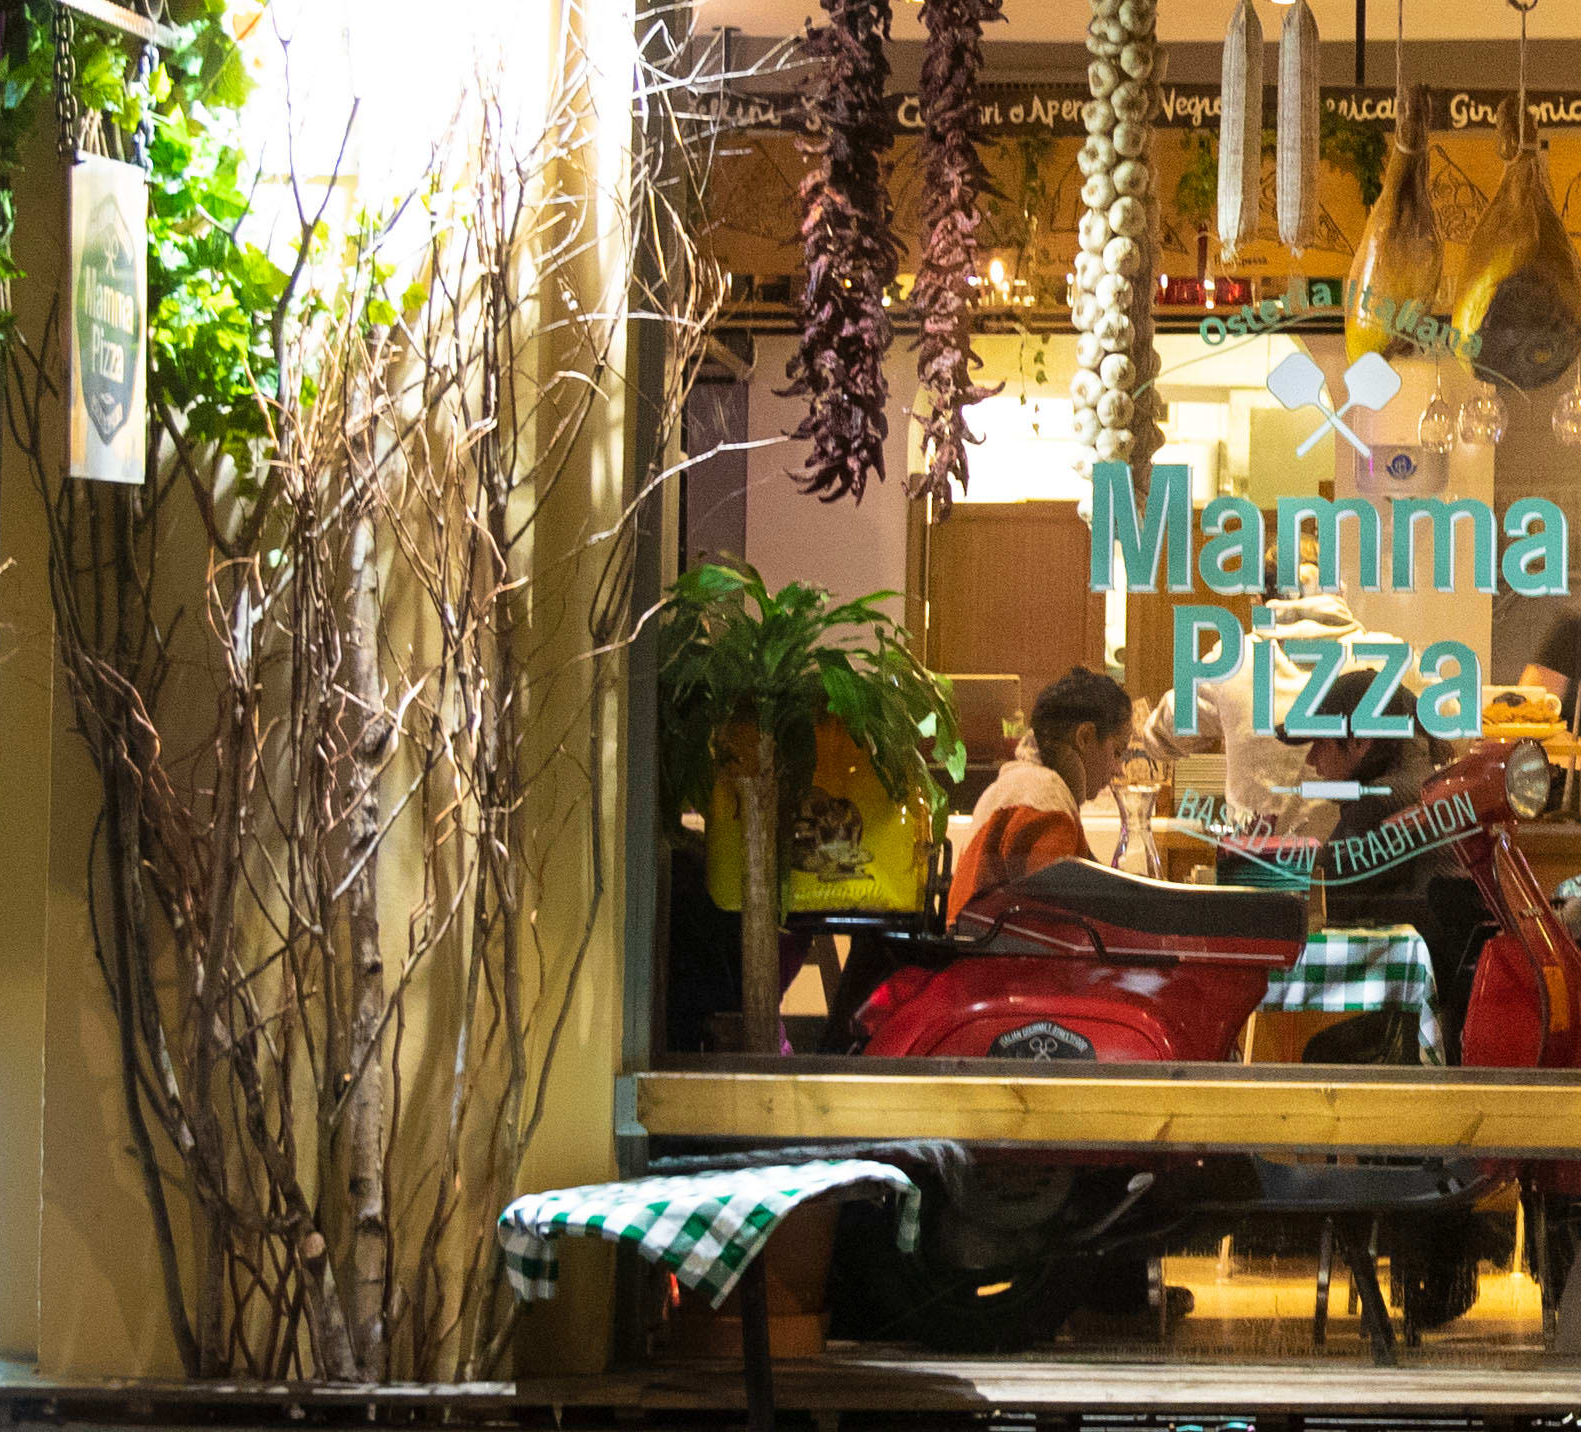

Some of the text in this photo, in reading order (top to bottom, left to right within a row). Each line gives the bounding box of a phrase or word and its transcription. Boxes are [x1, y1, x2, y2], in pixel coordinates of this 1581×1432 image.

[85, 264, 134, 335] Mamma
[1198, 277, 1483, 358] Osteria Italiana
[91, 324, 124, 384] Pizza
[1090, 460, 1569, 595] Mamma
[1172, 604, 1484, 738] Pizza
[1176, 788, 1479, 875] BASED ON TRADITION
